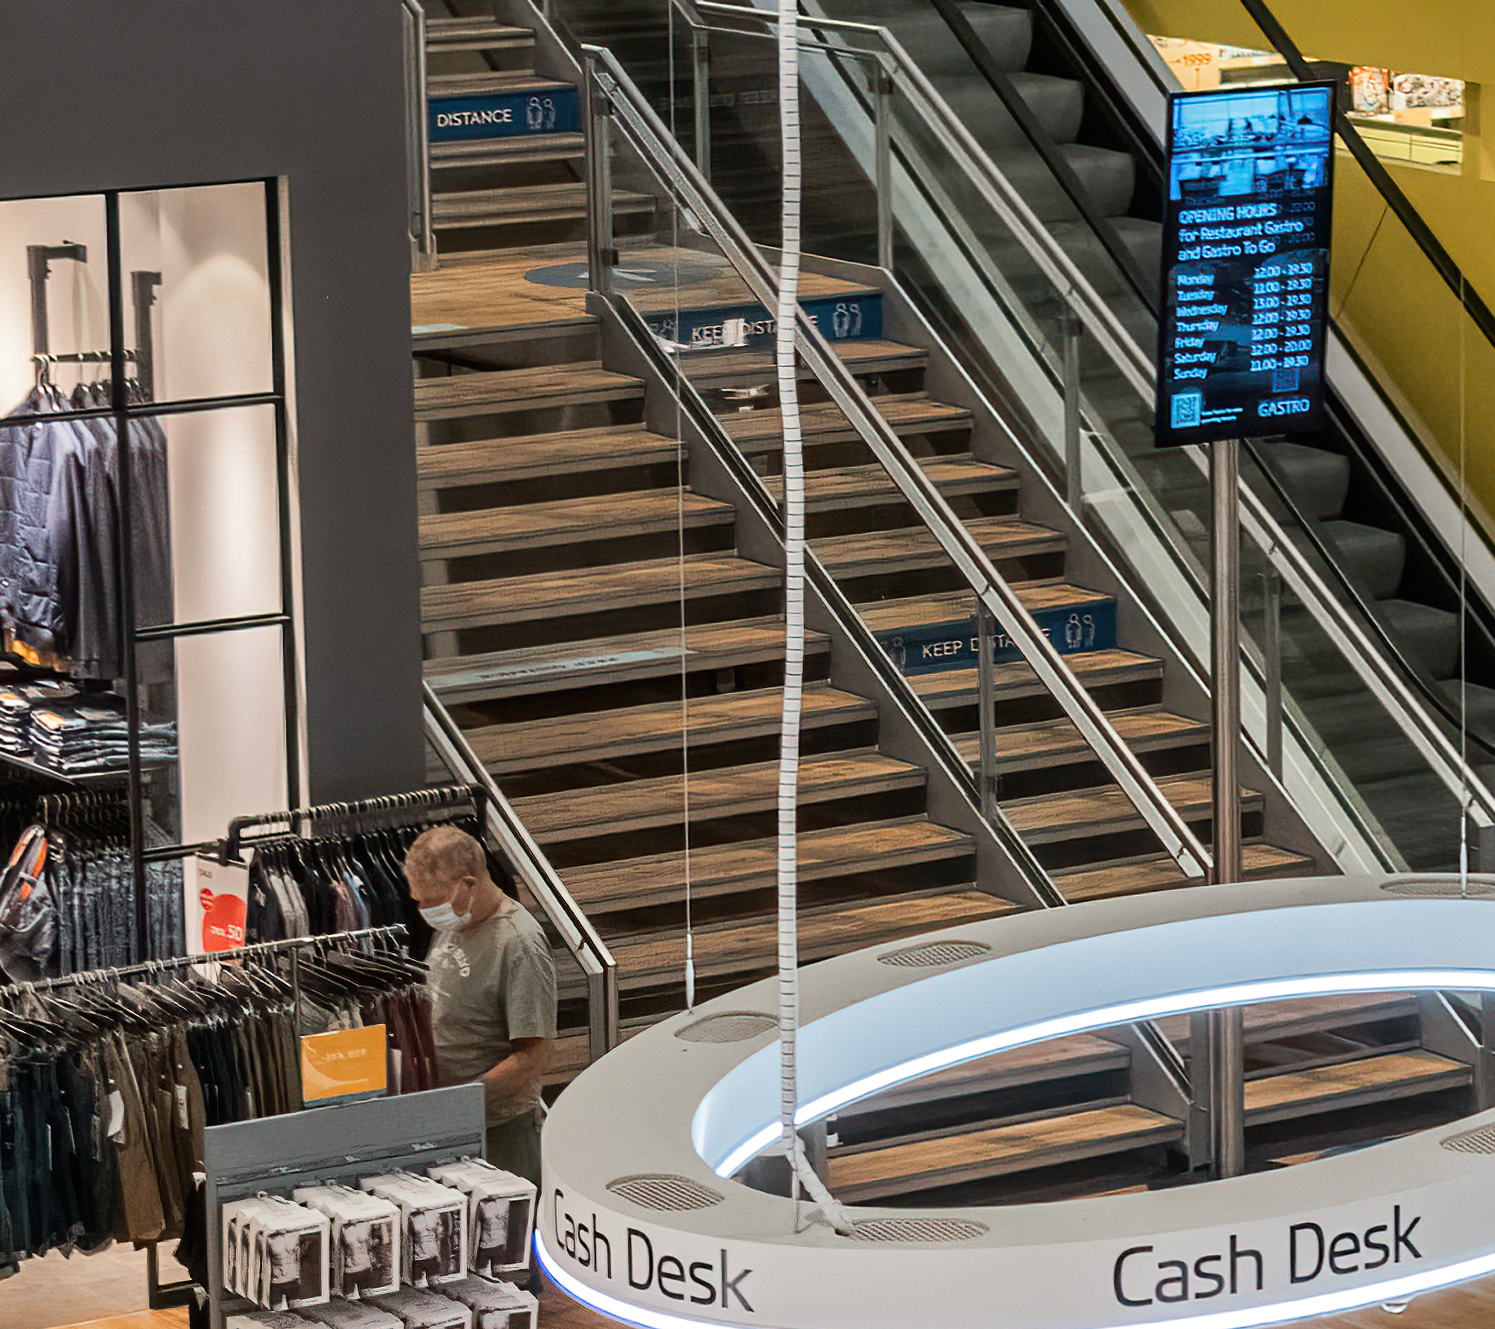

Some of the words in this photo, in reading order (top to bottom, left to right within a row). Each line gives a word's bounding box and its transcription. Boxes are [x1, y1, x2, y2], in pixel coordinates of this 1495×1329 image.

[436, 108, 514, 128] DISTANCE
[1177, 206, 1235, 224] OPENING
[1235, 202, 1278, 220] HOURS
[1178, 228, 1200, 243] for
[1200, 222, 1264, 240] Restaurant
[1264, 219, 1304, 235] Gastro
[1177, 246, 1201, 262] and
[1201, 243, 1242, 259] Gastro
[1242, 240, 1258, 255] To
[1258, 239, 1276, 254] Go
[1177, 272, 1215, 286] Monday
[1177, 288, 1215, 302] Tuesday
[1176, 302, 1228, 317] Wednesday
[1175, 318, 1220, 332] Thursday
[1174, 336, 1206, 349] Friday
[1173, 350, 1218, 365] Saturday
[1173, 368, 1208, 380] Sunday
[1257, 398, 1311, 418] GASTRO
[922, 639, 963, 659] KEEP
[554, 1189, 612, 1279] Cash
[627, 1226, 755, 1313] Desk
[1114, 1235, 1265, 1307] Cash
[1290, 1204, 1424, 1285] Desk
